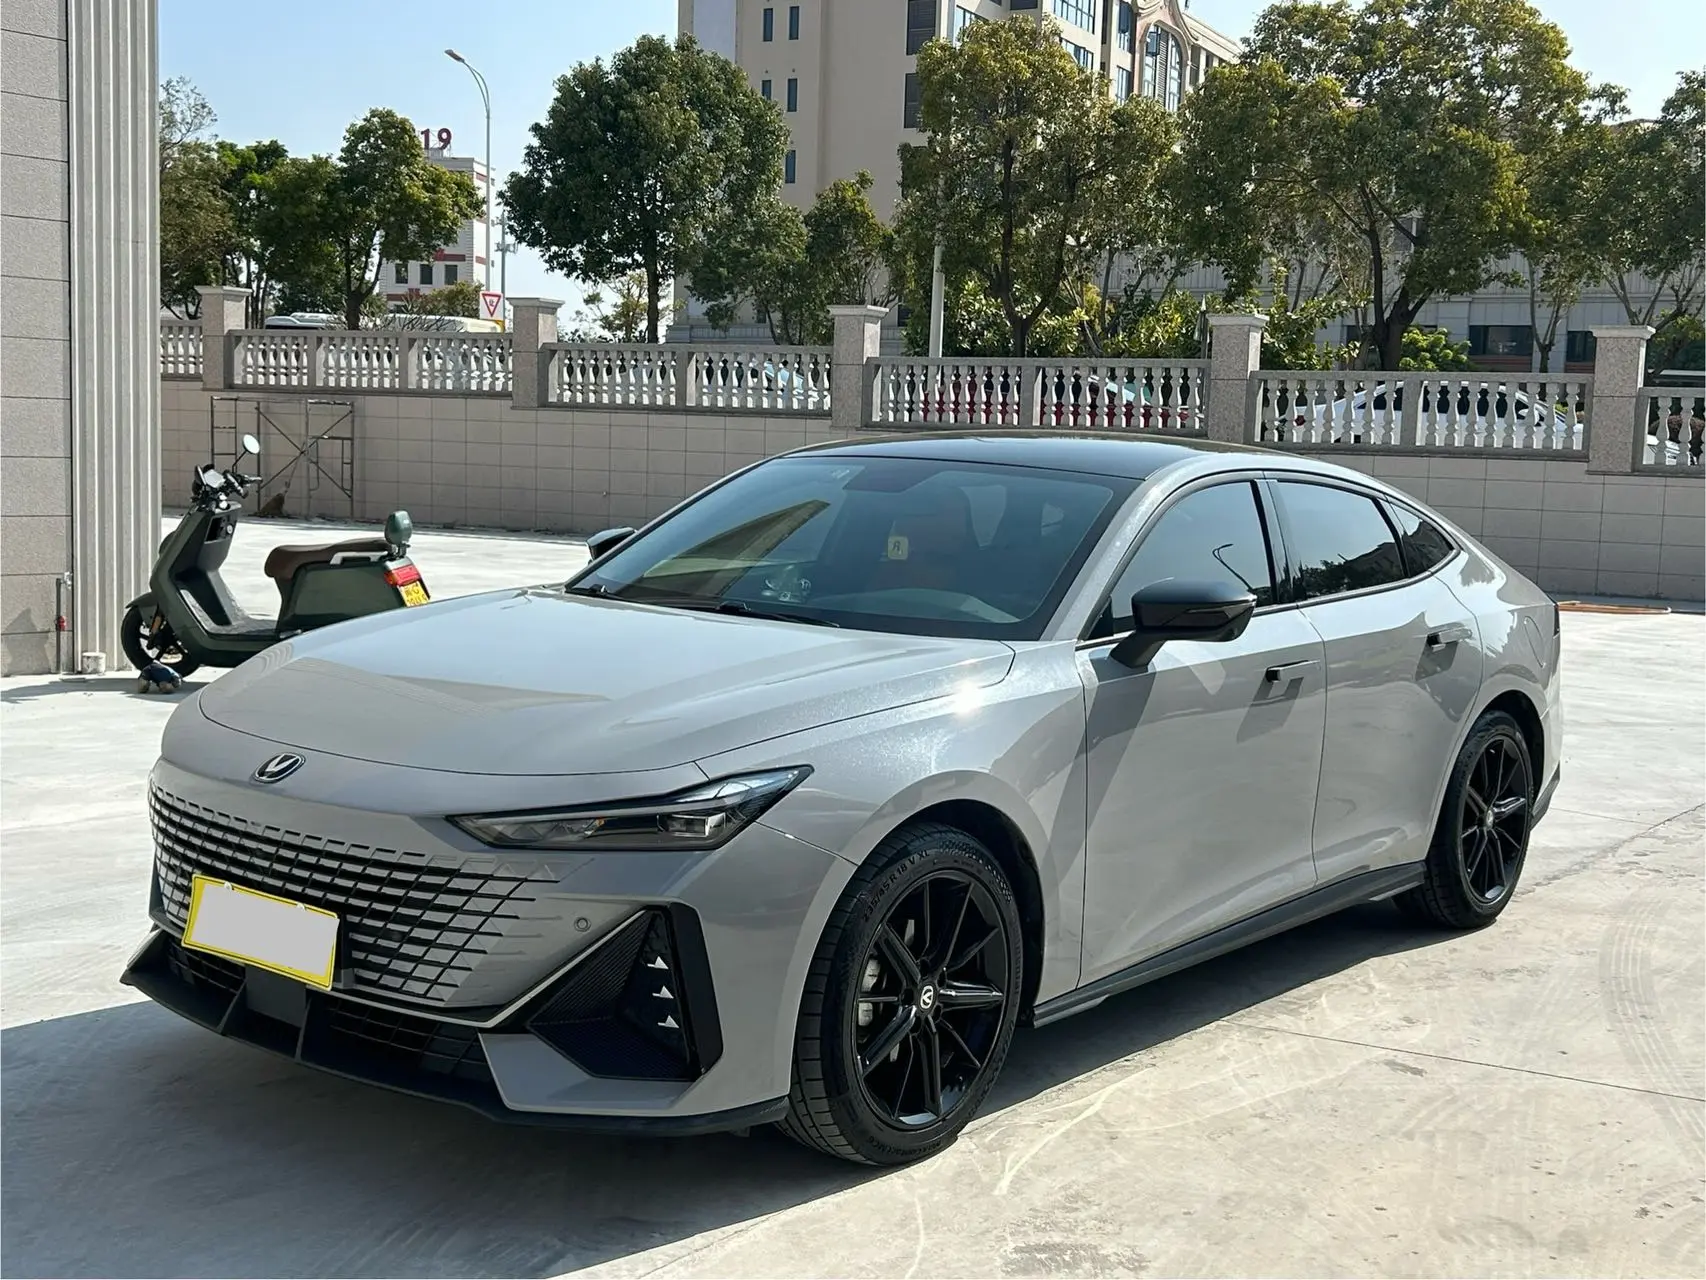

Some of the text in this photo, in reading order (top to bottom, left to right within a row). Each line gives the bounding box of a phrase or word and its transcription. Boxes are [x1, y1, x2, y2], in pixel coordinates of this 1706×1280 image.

[421, 128, 452, 150] 19
[889, 874, 897, 883] R
[897, 864, 907, 875] 18
[908, 856, 916, 865] V
[917, 850, 930, 859] XL
